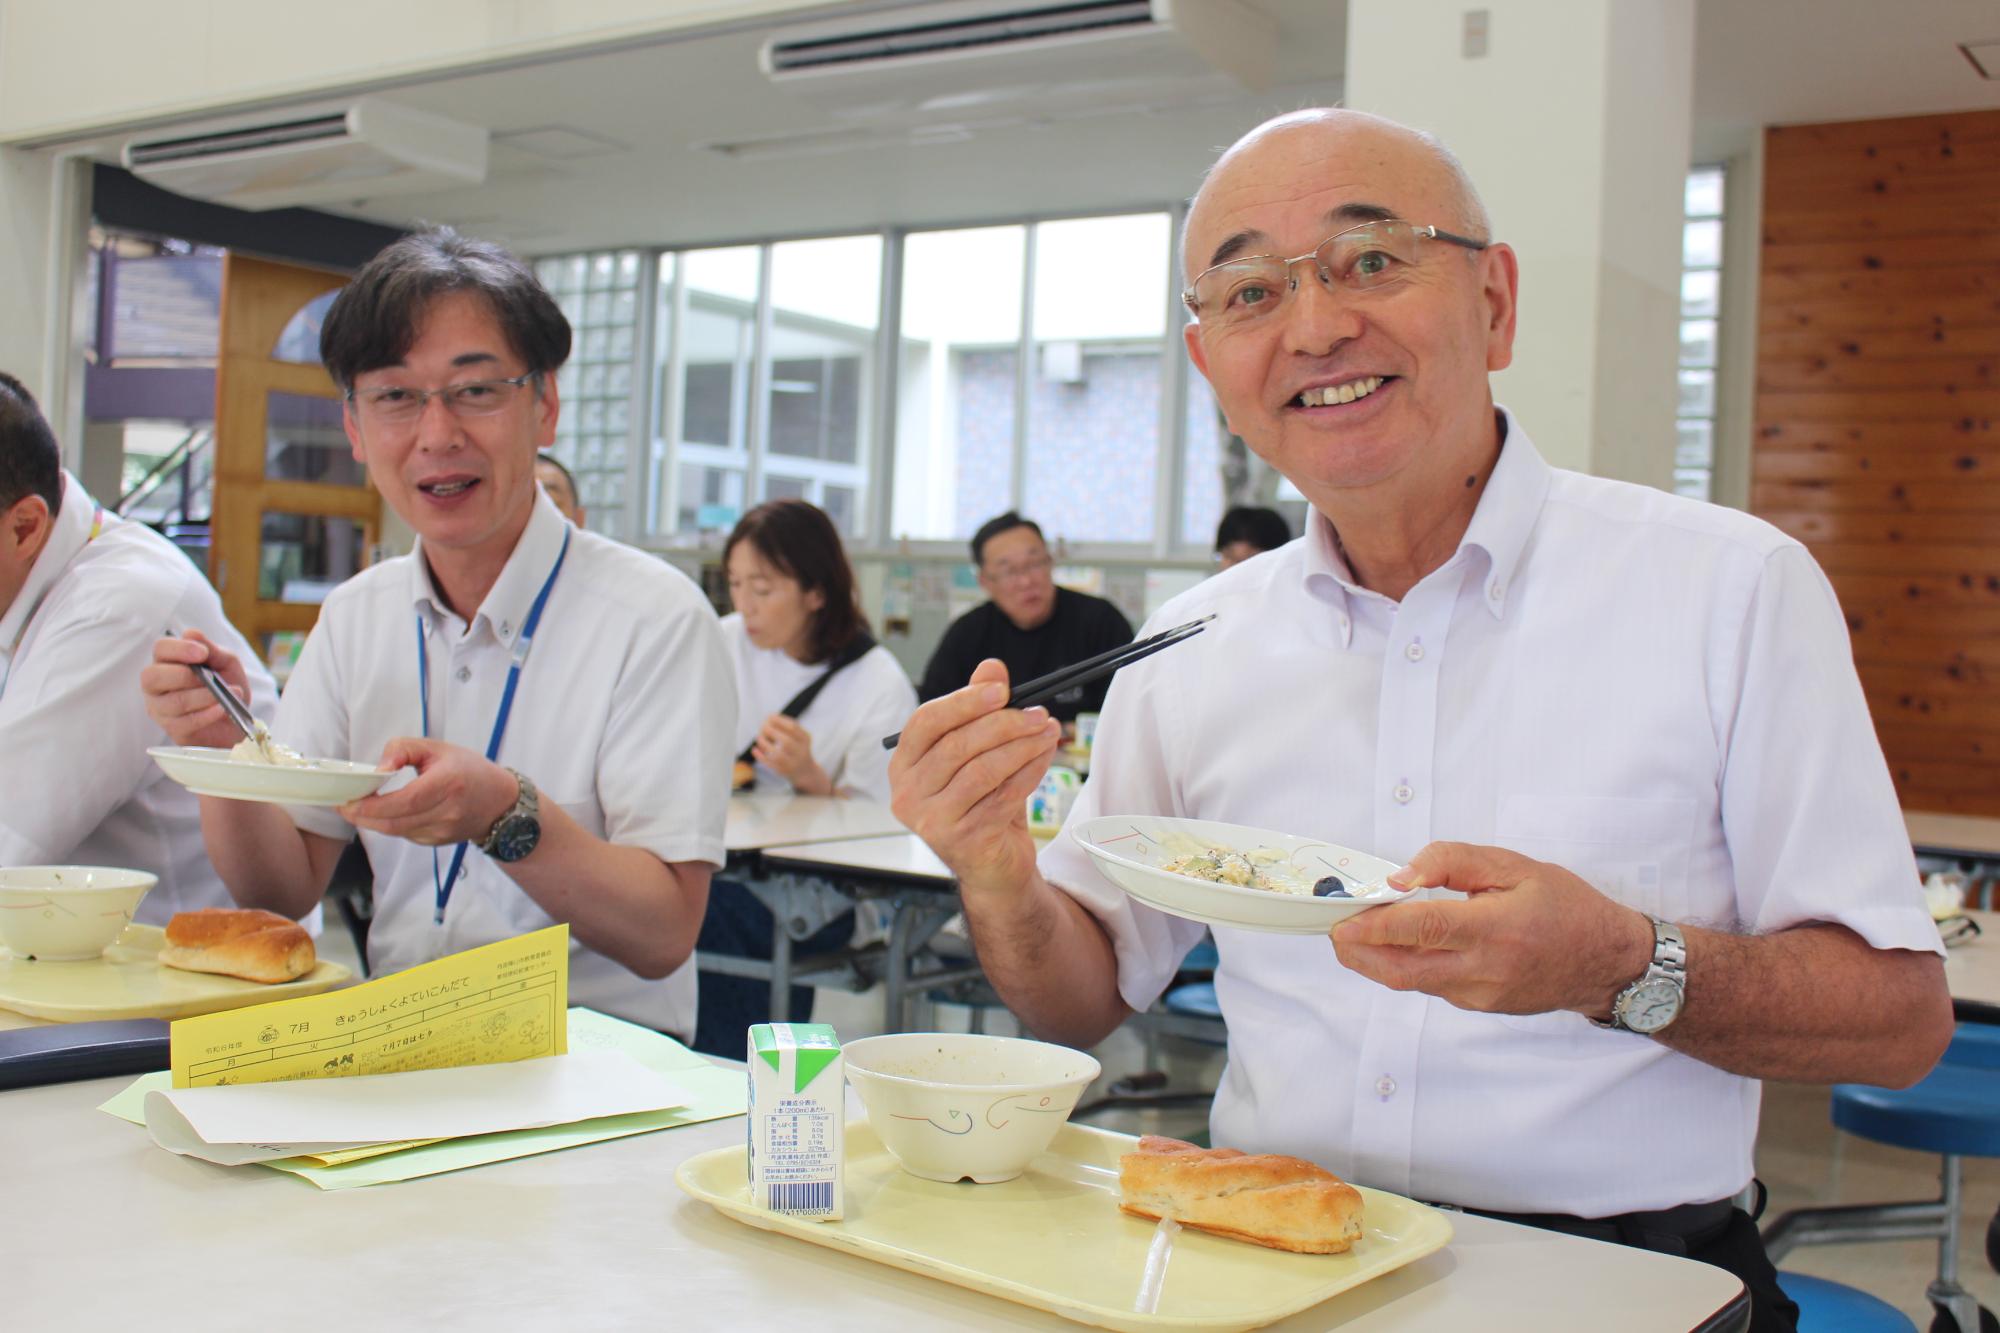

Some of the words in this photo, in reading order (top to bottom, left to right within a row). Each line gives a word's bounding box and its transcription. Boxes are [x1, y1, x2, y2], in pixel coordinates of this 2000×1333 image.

[289, 1022, 310, 1034] 7月
[227, 1058, 236, 1067] 月
[385, 1023, 393, 1031] 水
[780, 1099, 817, 1107] 栄養成分表示
